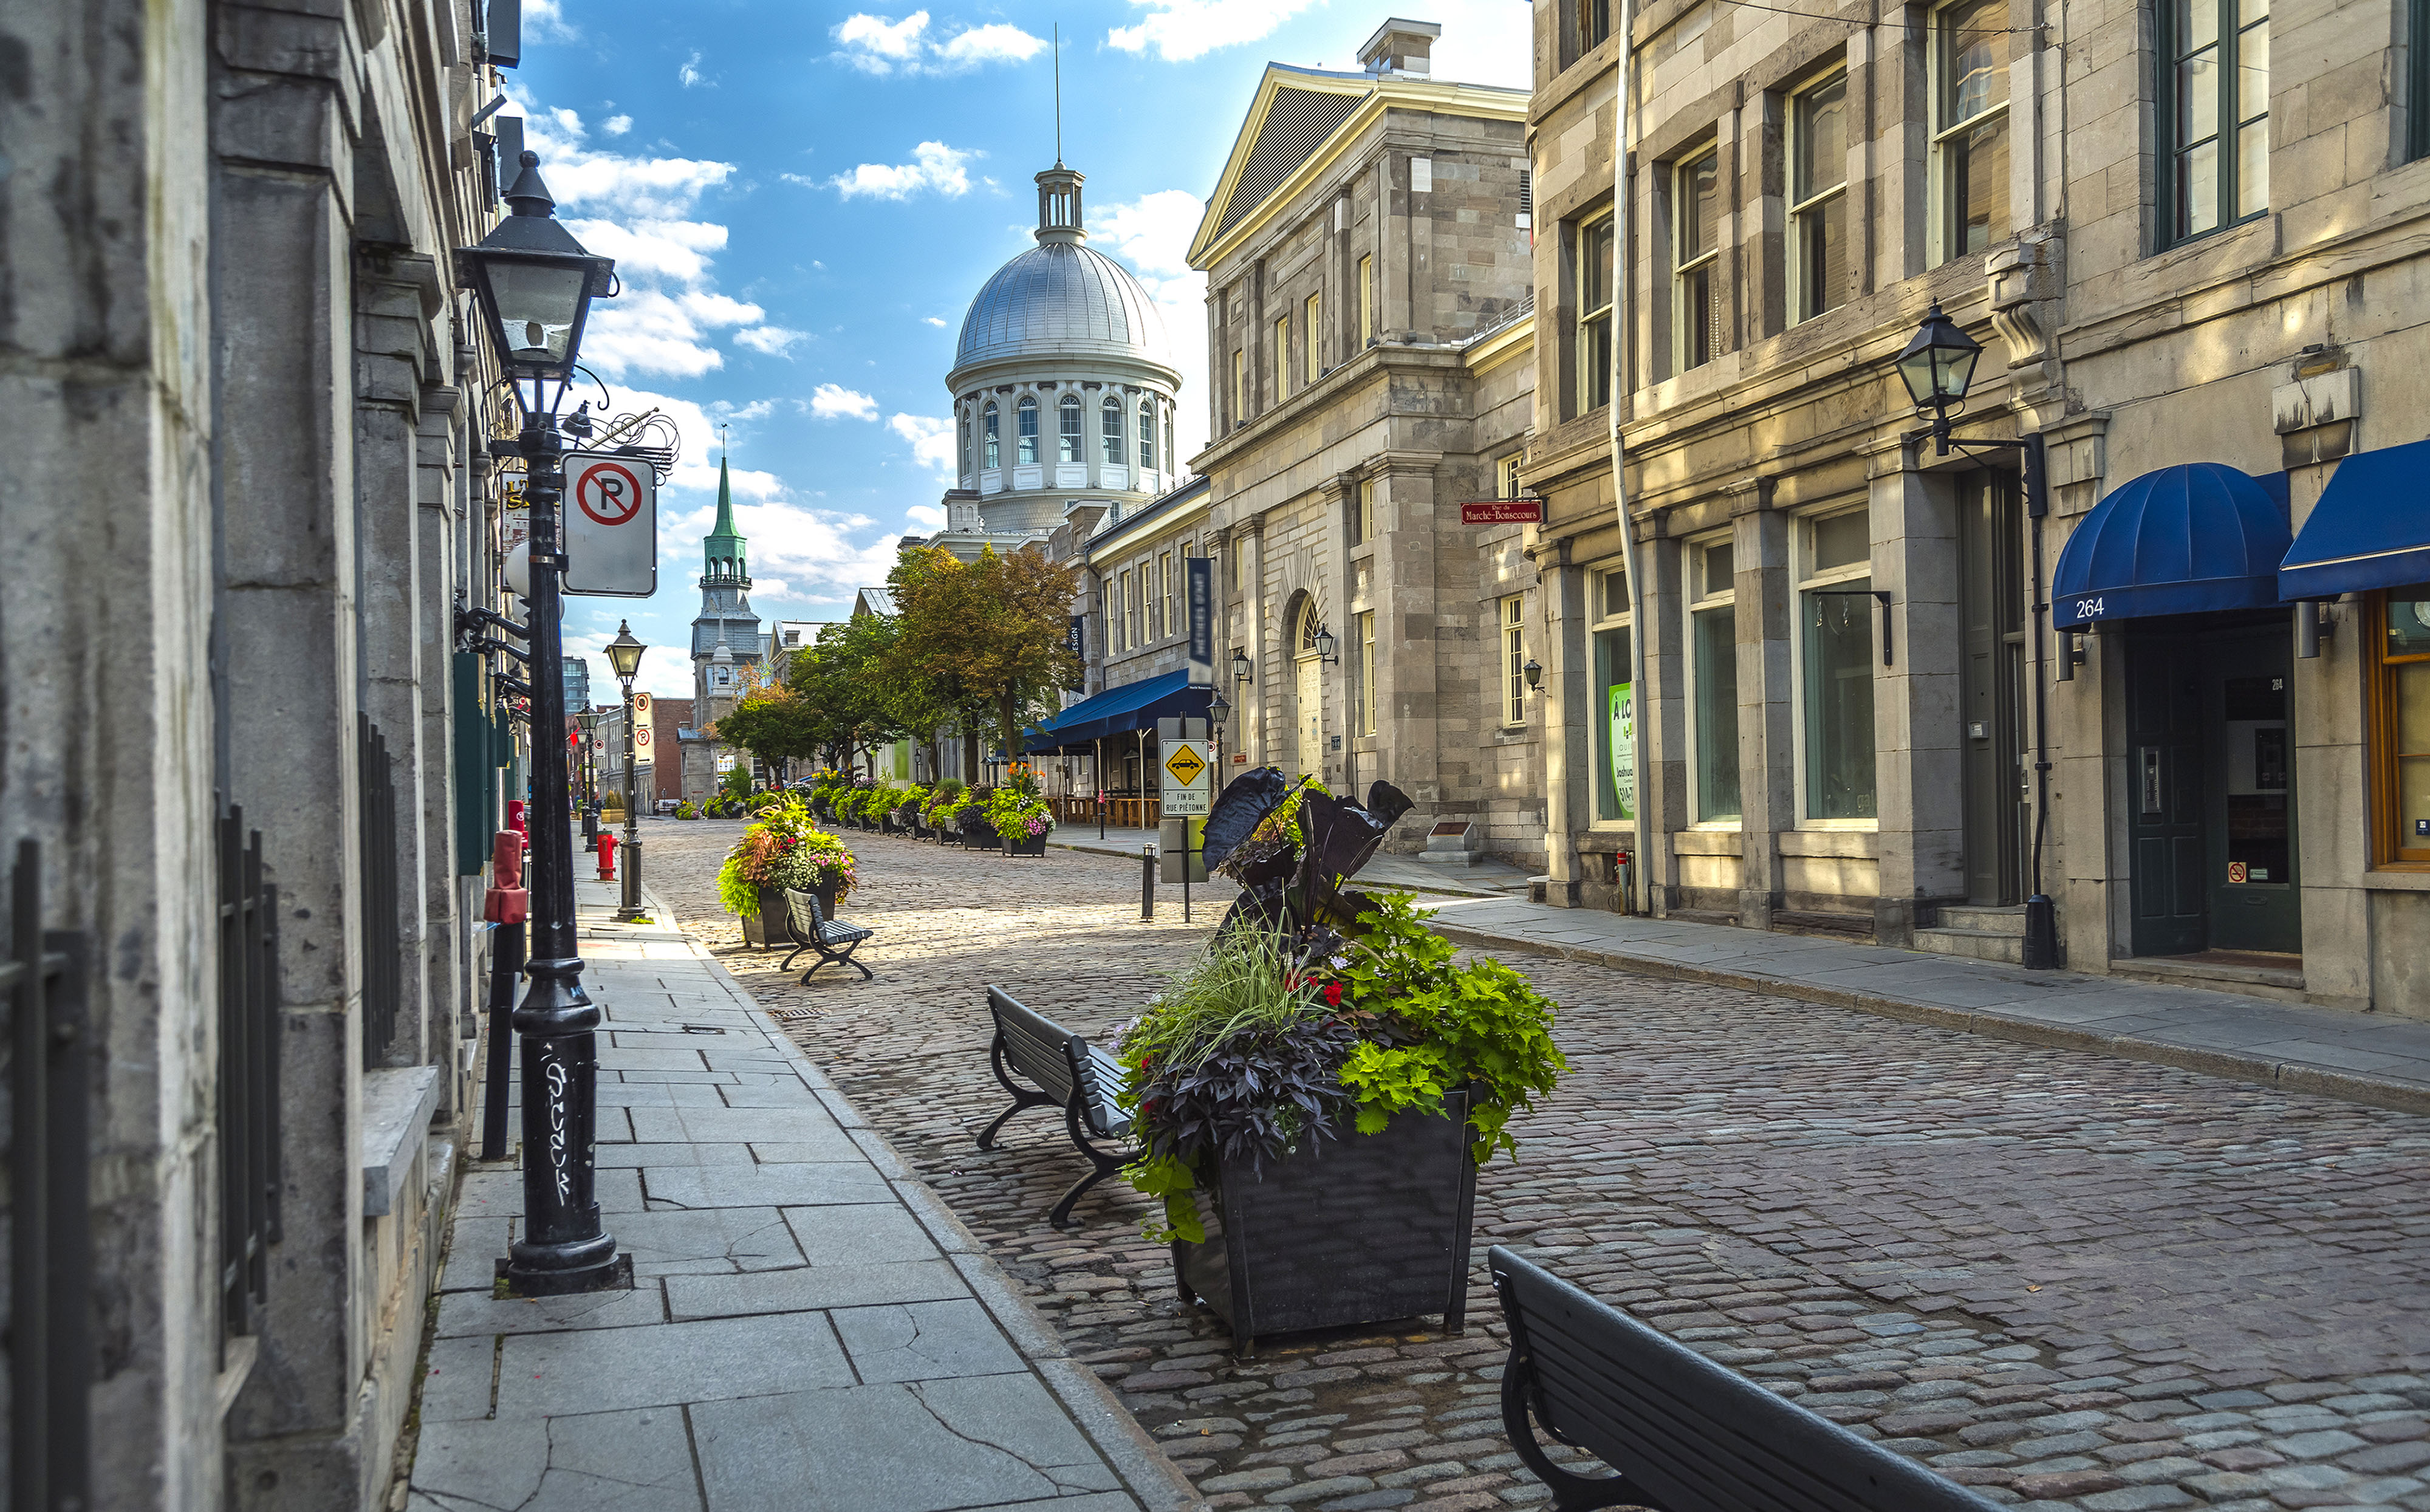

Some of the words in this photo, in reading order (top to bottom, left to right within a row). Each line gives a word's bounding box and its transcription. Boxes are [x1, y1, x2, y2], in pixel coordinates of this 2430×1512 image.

[601, 477, 623, 510] P
[1466, 511, 1537, 521] Marché-Bonsecours
[2076, 597, 2104, 619] 264
[2272, 679, 2283, 690] 264
[1614, 695, 1620, 720] À
[1622, 699, 1631, 719] LO
[1619, 787, 1634, 802] 514-7
